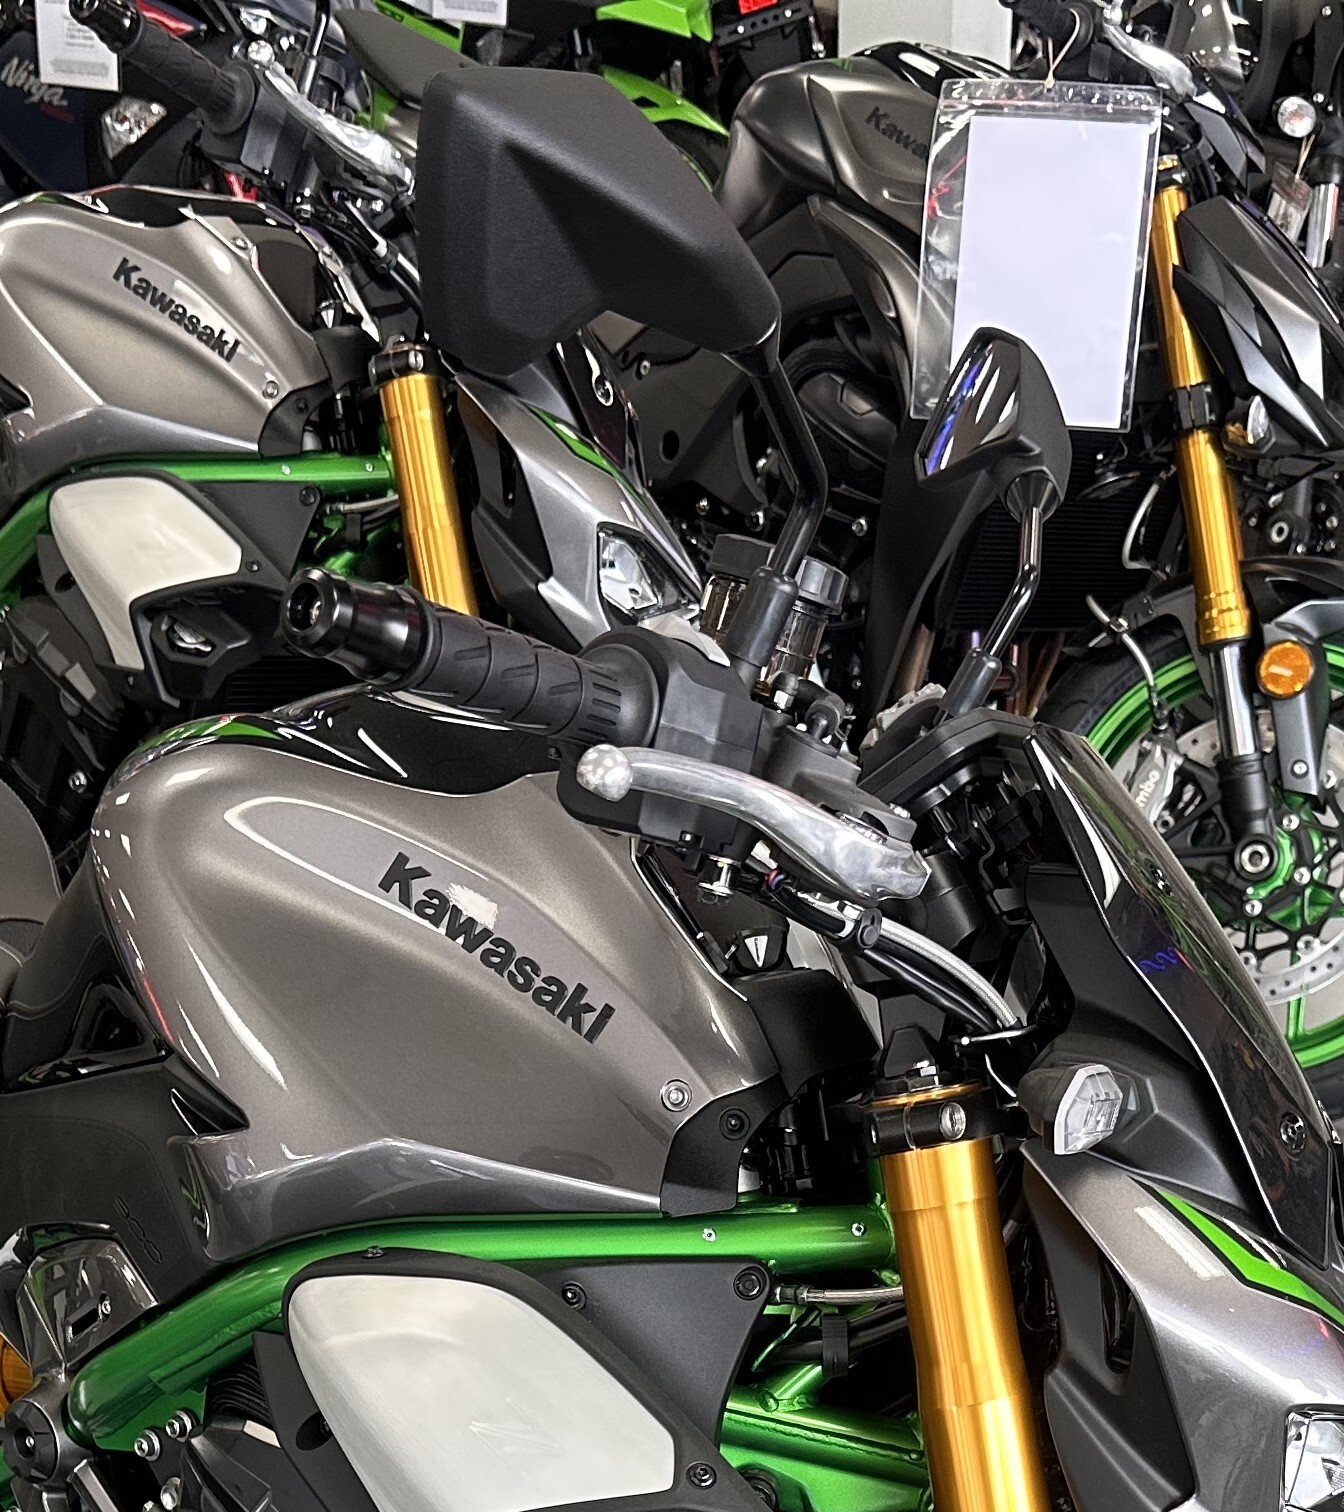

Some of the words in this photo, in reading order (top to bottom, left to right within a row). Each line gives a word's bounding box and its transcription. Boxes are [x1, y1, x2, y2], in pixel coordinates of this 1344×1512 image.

[0, 57, 68, 106] Ninja
[865, 106, 929, 160] Kawa
[113, 257, 241, 363] Kawasaki
[1136, 770, 1160, 808] mbo
[378, 851, 616, 1044] Kawasaki
